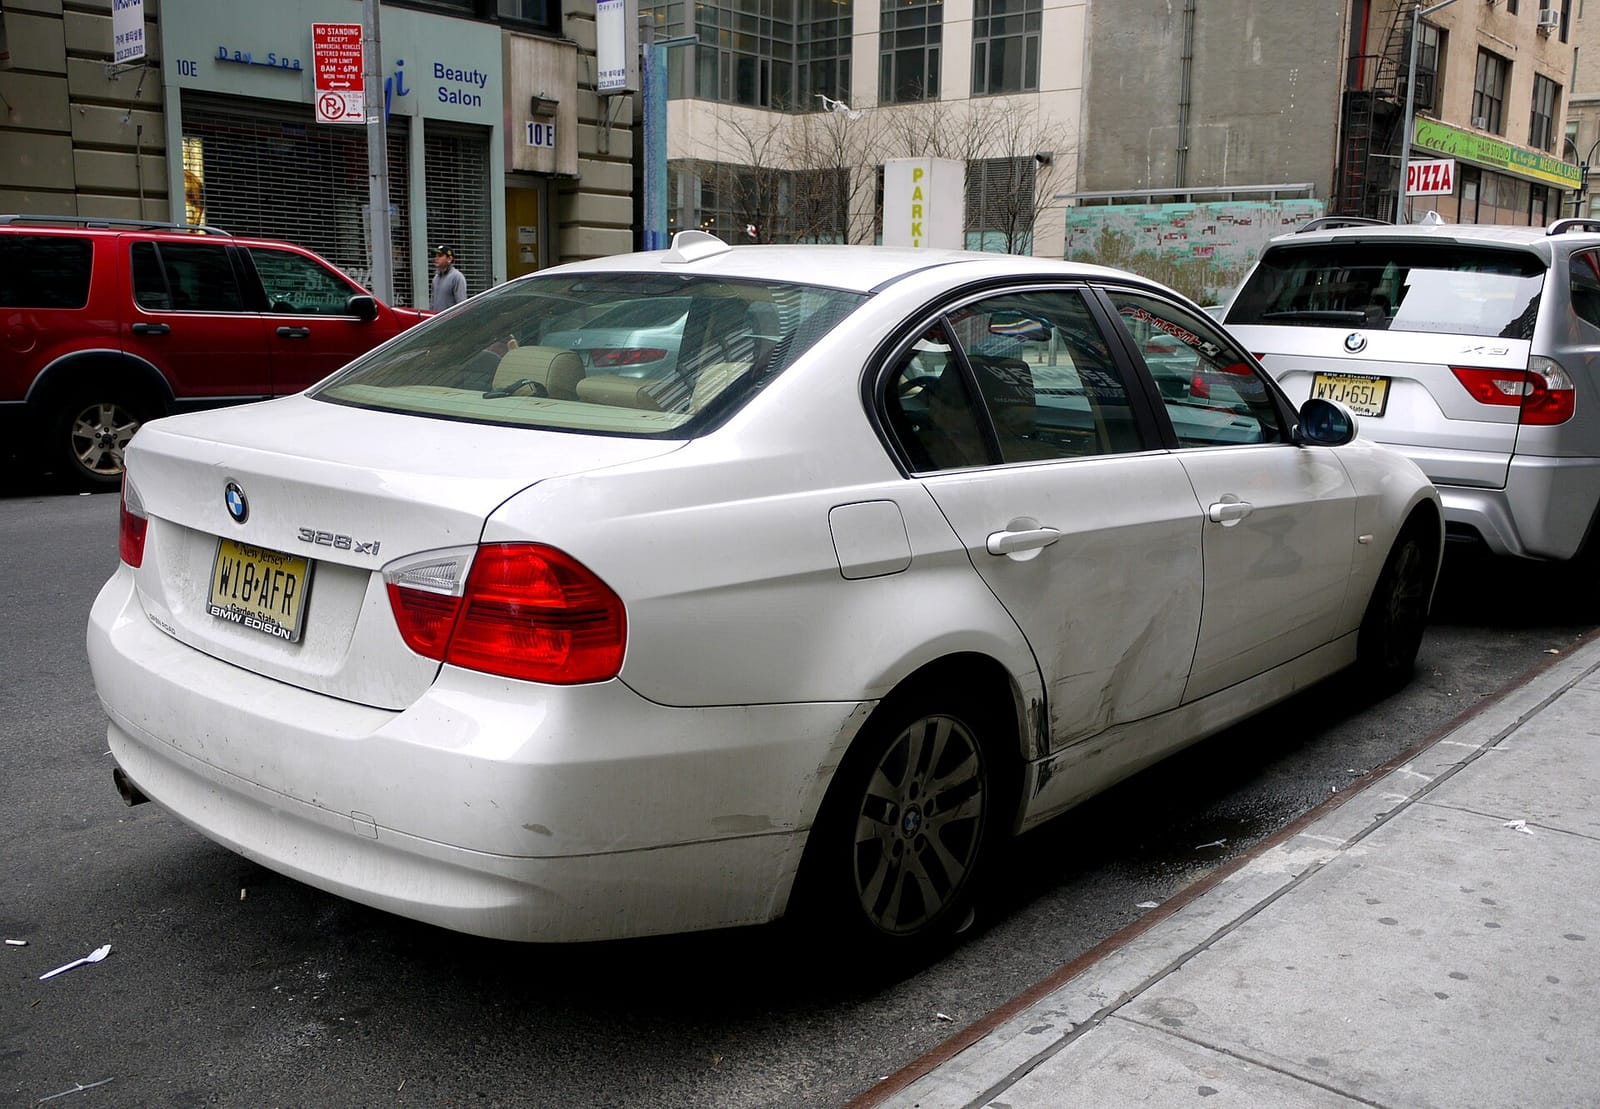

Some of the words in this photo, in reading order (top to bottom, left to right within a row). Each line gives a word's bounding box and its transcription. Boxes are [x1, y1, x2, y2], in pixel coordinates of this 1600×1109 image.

[316, 27, 326, 35] NO
[327, 28, 359, 36] STANDING
[176, 59, 197, 77] 10E
[218, 46, 252, 64] Day
[267, 52, 301, 70] Spa
[343, 65, 359, 73] 6PM
[433, 62, 487, 89] Beauty
[438, 87, 482, 107] Salon
[528, 122, 542, 146] 10
[546, 125, 553, 147] E
[1477, 141, 1490, 153] HAIR
[1491, 143, 1510, 160] STUDIO
[1407, 164, 1451, 192] PIZZA
[1540, 156, 1564, 175] MEDICAL
[1564, 163, 1580, 180] LASER
[240, 545, 258, 560] New
[258, 549, 285, 569] Jersey
[210, 606, 242, 623] BMW
[244, 617, 291, 640] EDISON
[230, 603, 256, 618] Garden
[257, 611, 276, 625] State
